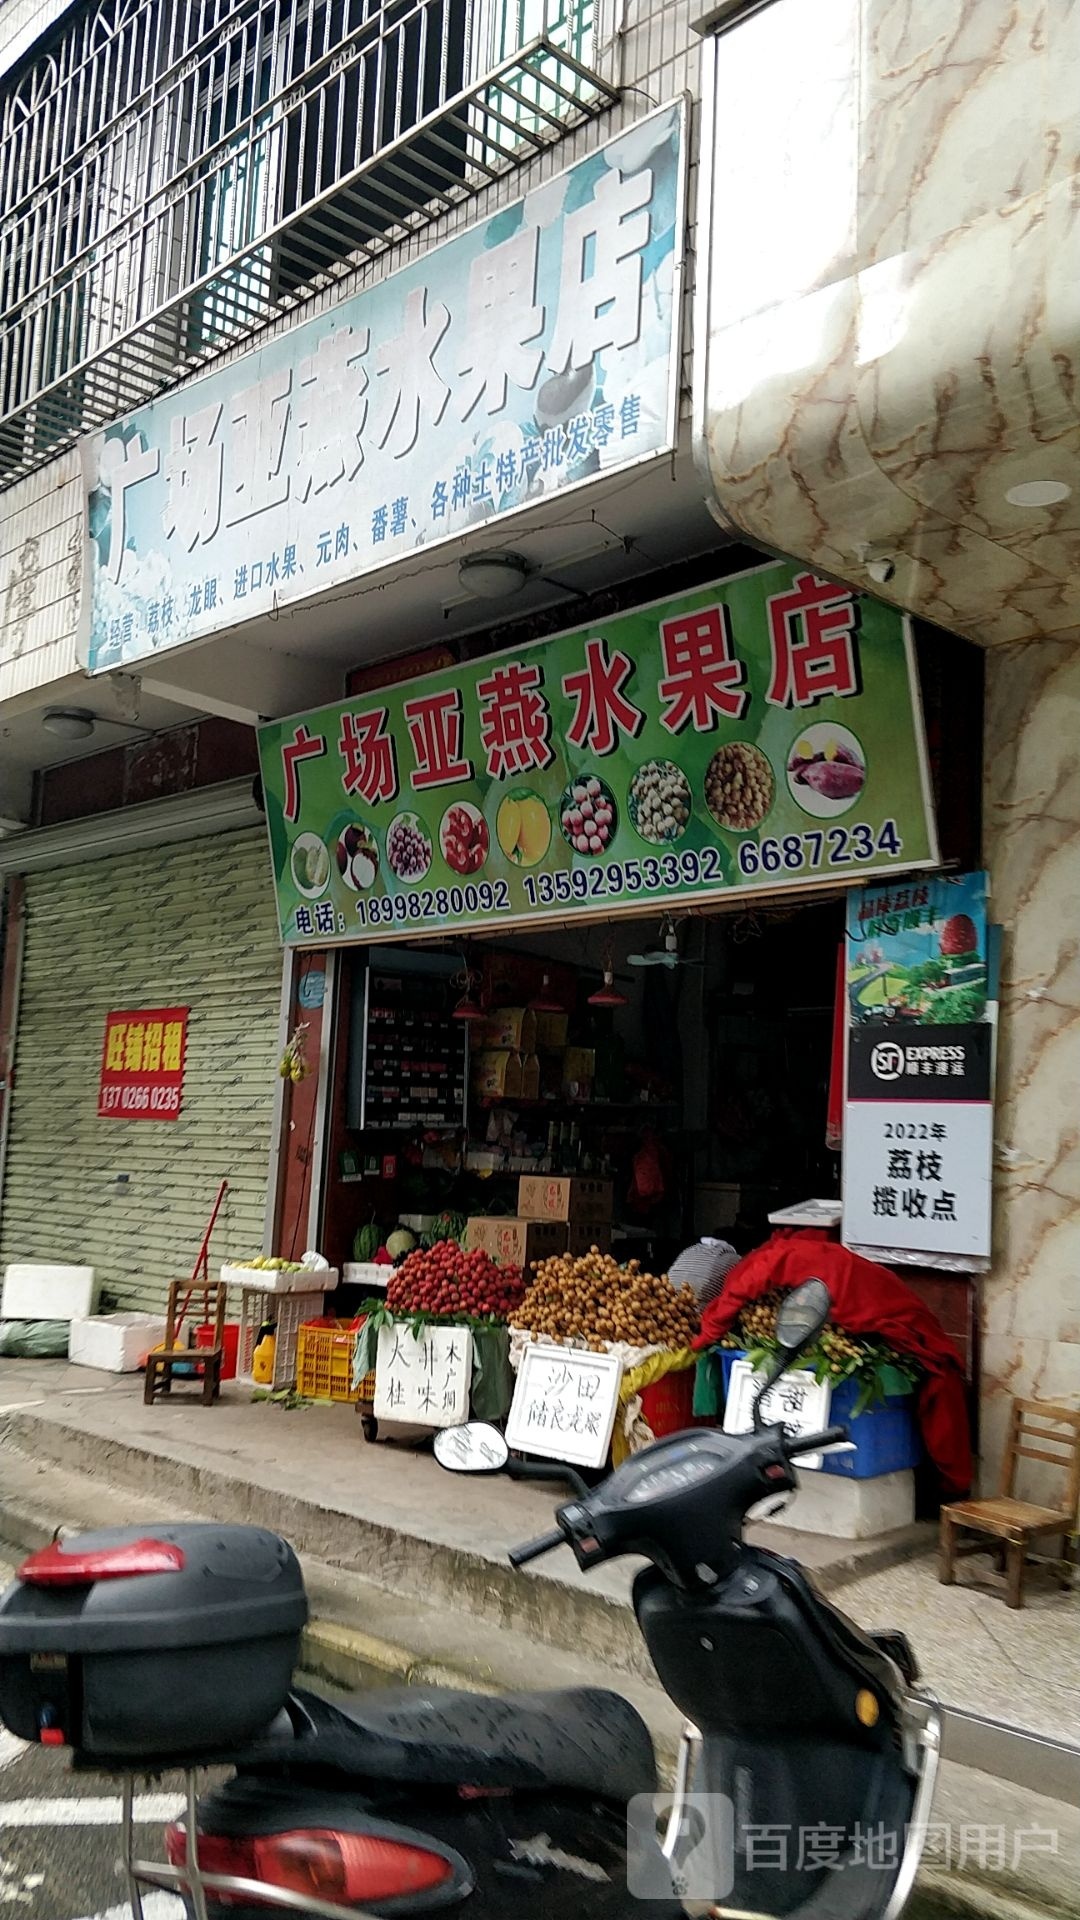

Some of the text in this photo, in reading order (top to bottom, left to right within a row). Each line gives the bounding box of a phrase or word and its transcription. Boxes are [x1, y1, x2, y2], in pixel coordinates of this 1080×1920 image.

[105, 168, 654, 585] 广场亚燕水果店
[281, 571, 860, 823] 广场亚燕水果店
[356, 881, 510, 927] 18998280092
[522, 847, 722, 907] 13592953392
[739, 819, 902, 876] 6687234
[906, 1046, 966, 1061] EXPRESS
[883, 1122, 948, 1142] 2022年
[887, 1149, 944, 1181] 荔枝
[872, 1185, 958, 1221] 揽收点
[545, 1363, 601, 1401] 沙田
